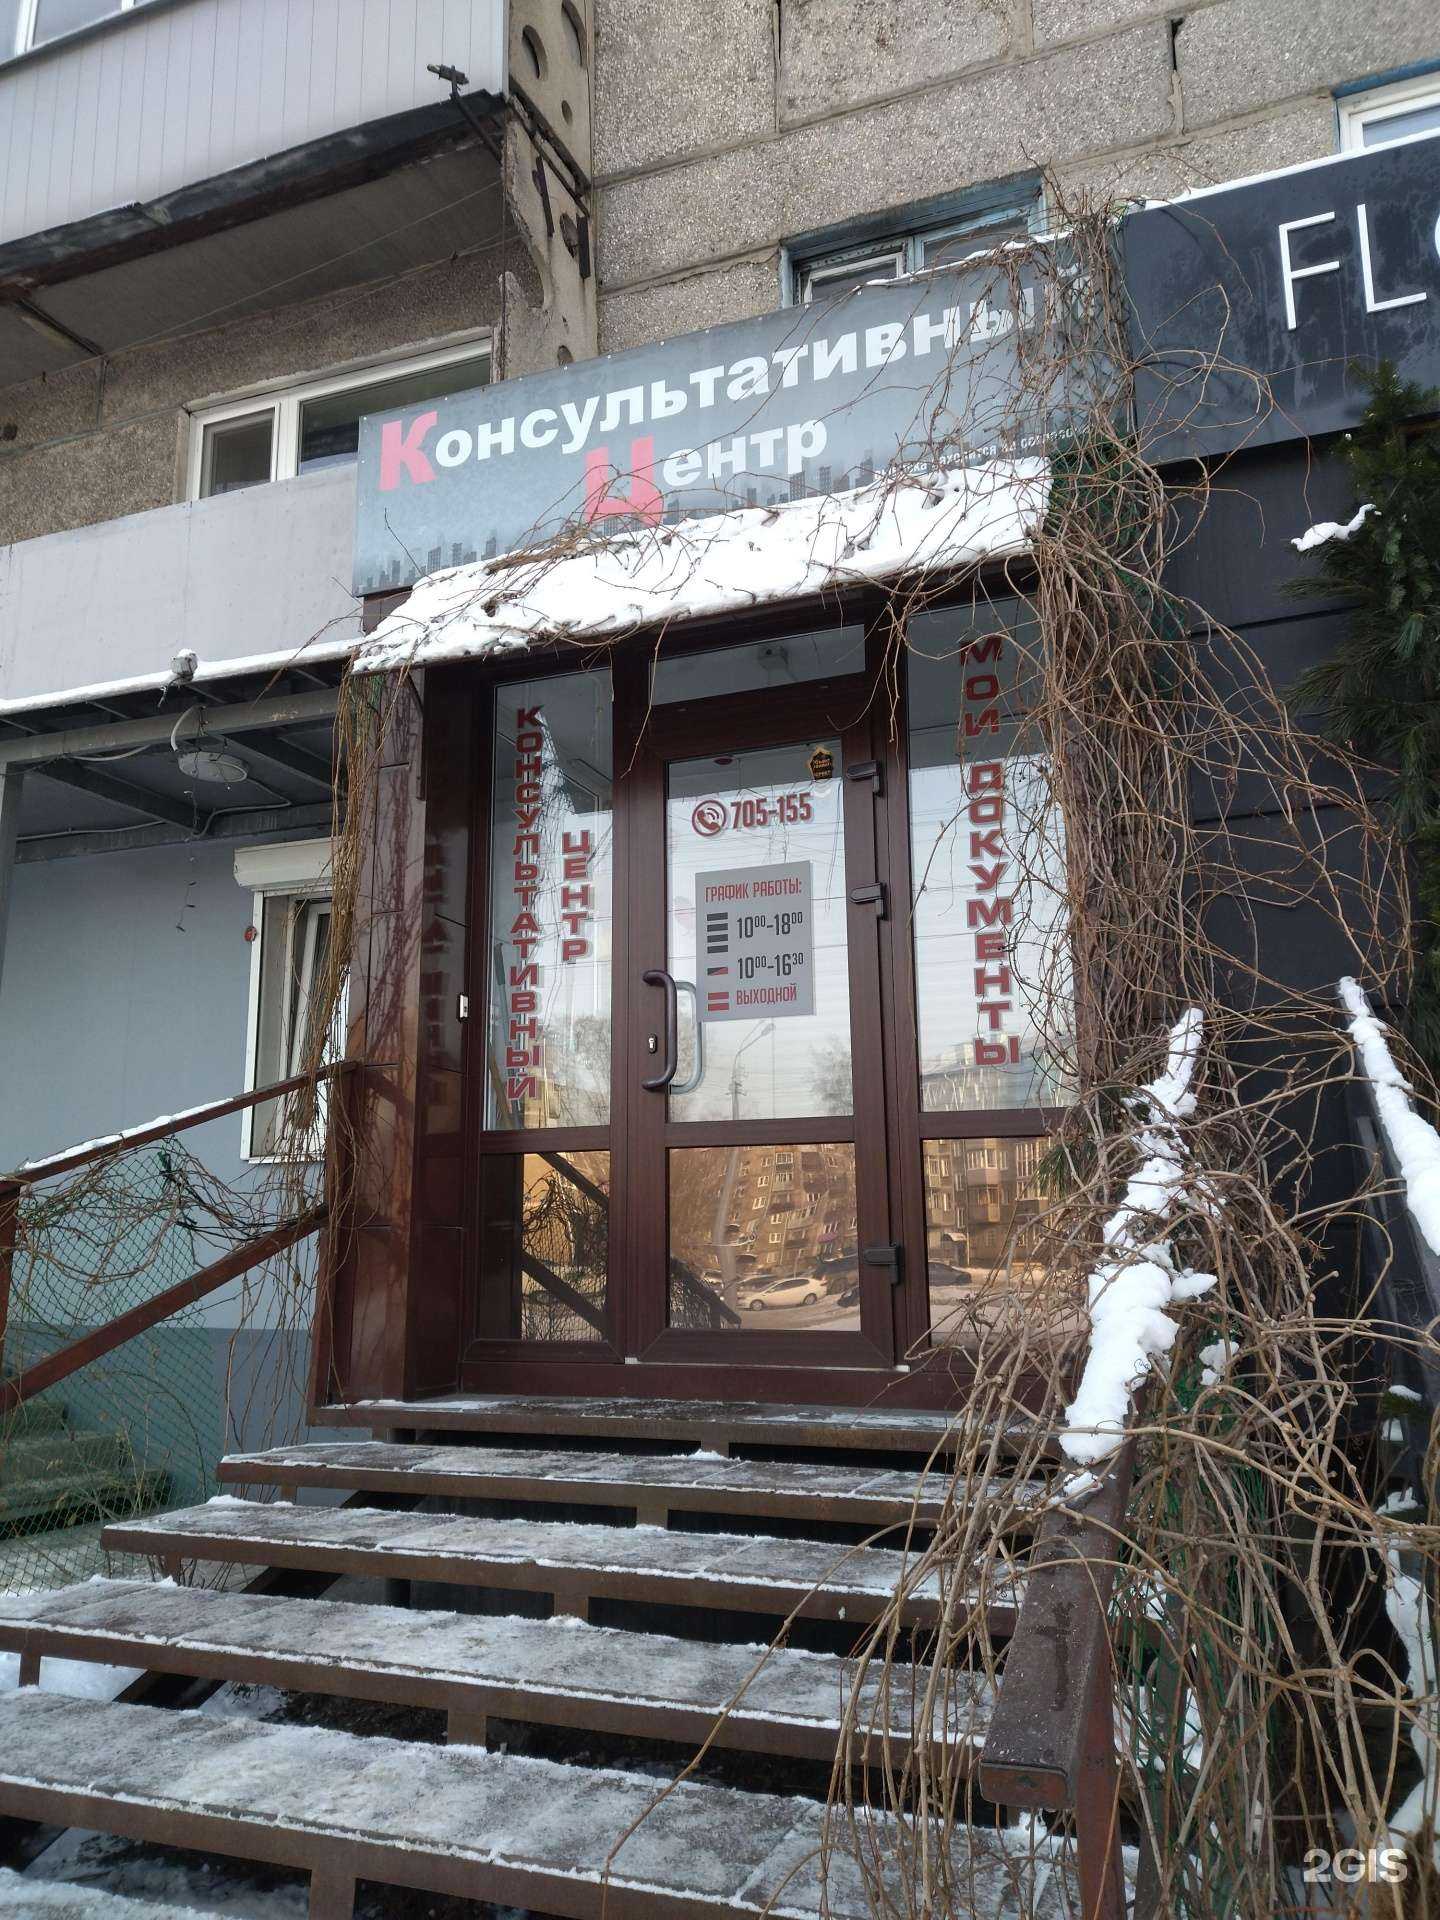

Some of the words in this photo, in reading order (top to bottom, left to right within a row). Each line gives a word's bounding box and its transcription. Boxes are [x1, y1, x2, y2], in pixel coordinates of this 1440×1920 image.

[1279, 203, 1440, 330] FL
[584, 419, 827, 529] Центр
[730, 792, 812, 829] 705-155
[505, 704, 544, 1100] КОНСУЛЬТАТИВНЫЙ
[561, 829, 591, 962] ЦЕНТР
[705, 882, 749, 903] ГРАФИК
[752, 877, 802, 898] РАБОТЫ:
[966, 761, 1020, 1066] ДОКУМЕНТЫ
[736, 982, 797, 1006] ВЫХОДНОЙ
